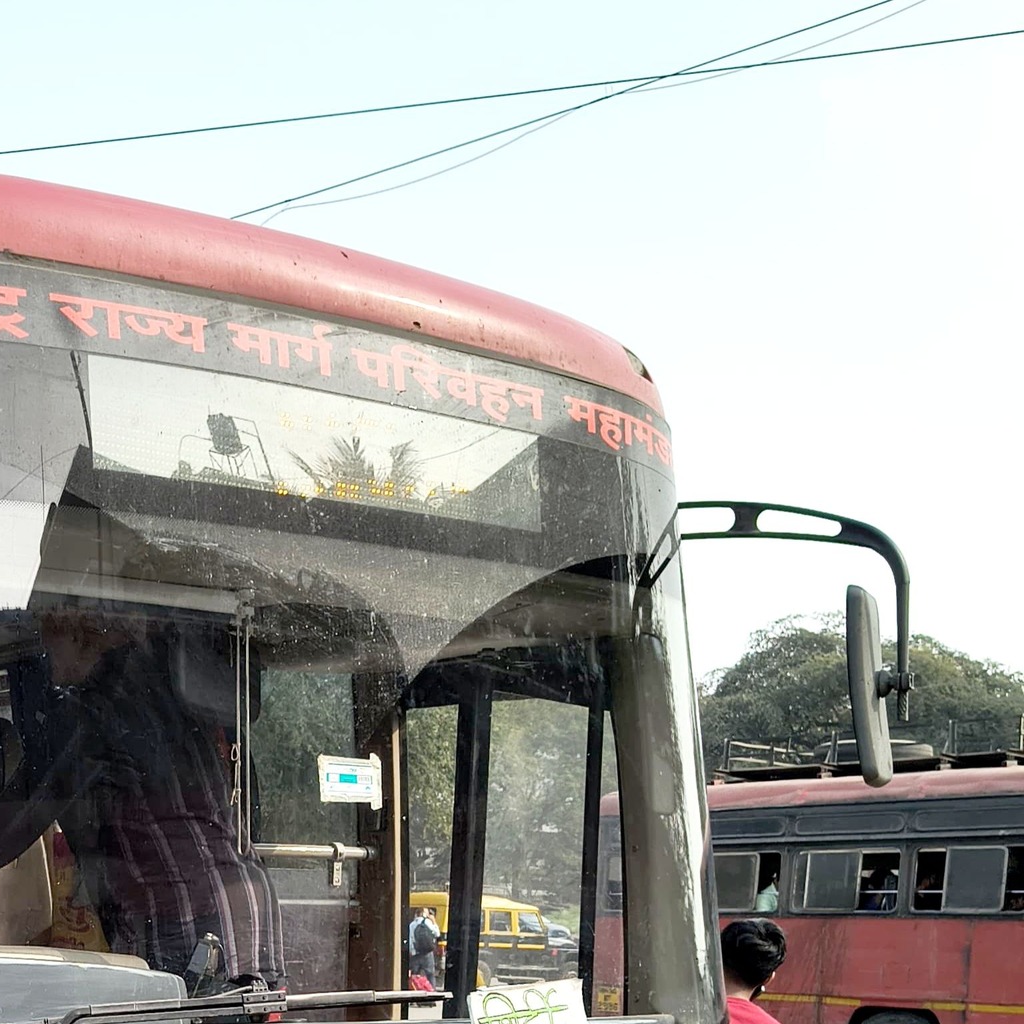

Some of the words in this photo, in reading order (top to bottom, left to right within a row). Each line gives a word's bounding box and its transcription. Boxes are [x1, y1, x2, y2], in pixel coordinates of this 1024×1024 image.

[49, 293, 208, 353] राज्य
[227, 322, 334, 377] मार्ग
[350, 344, 545, 422] परिवहन
[562, 395, 673, 468] महामंड
